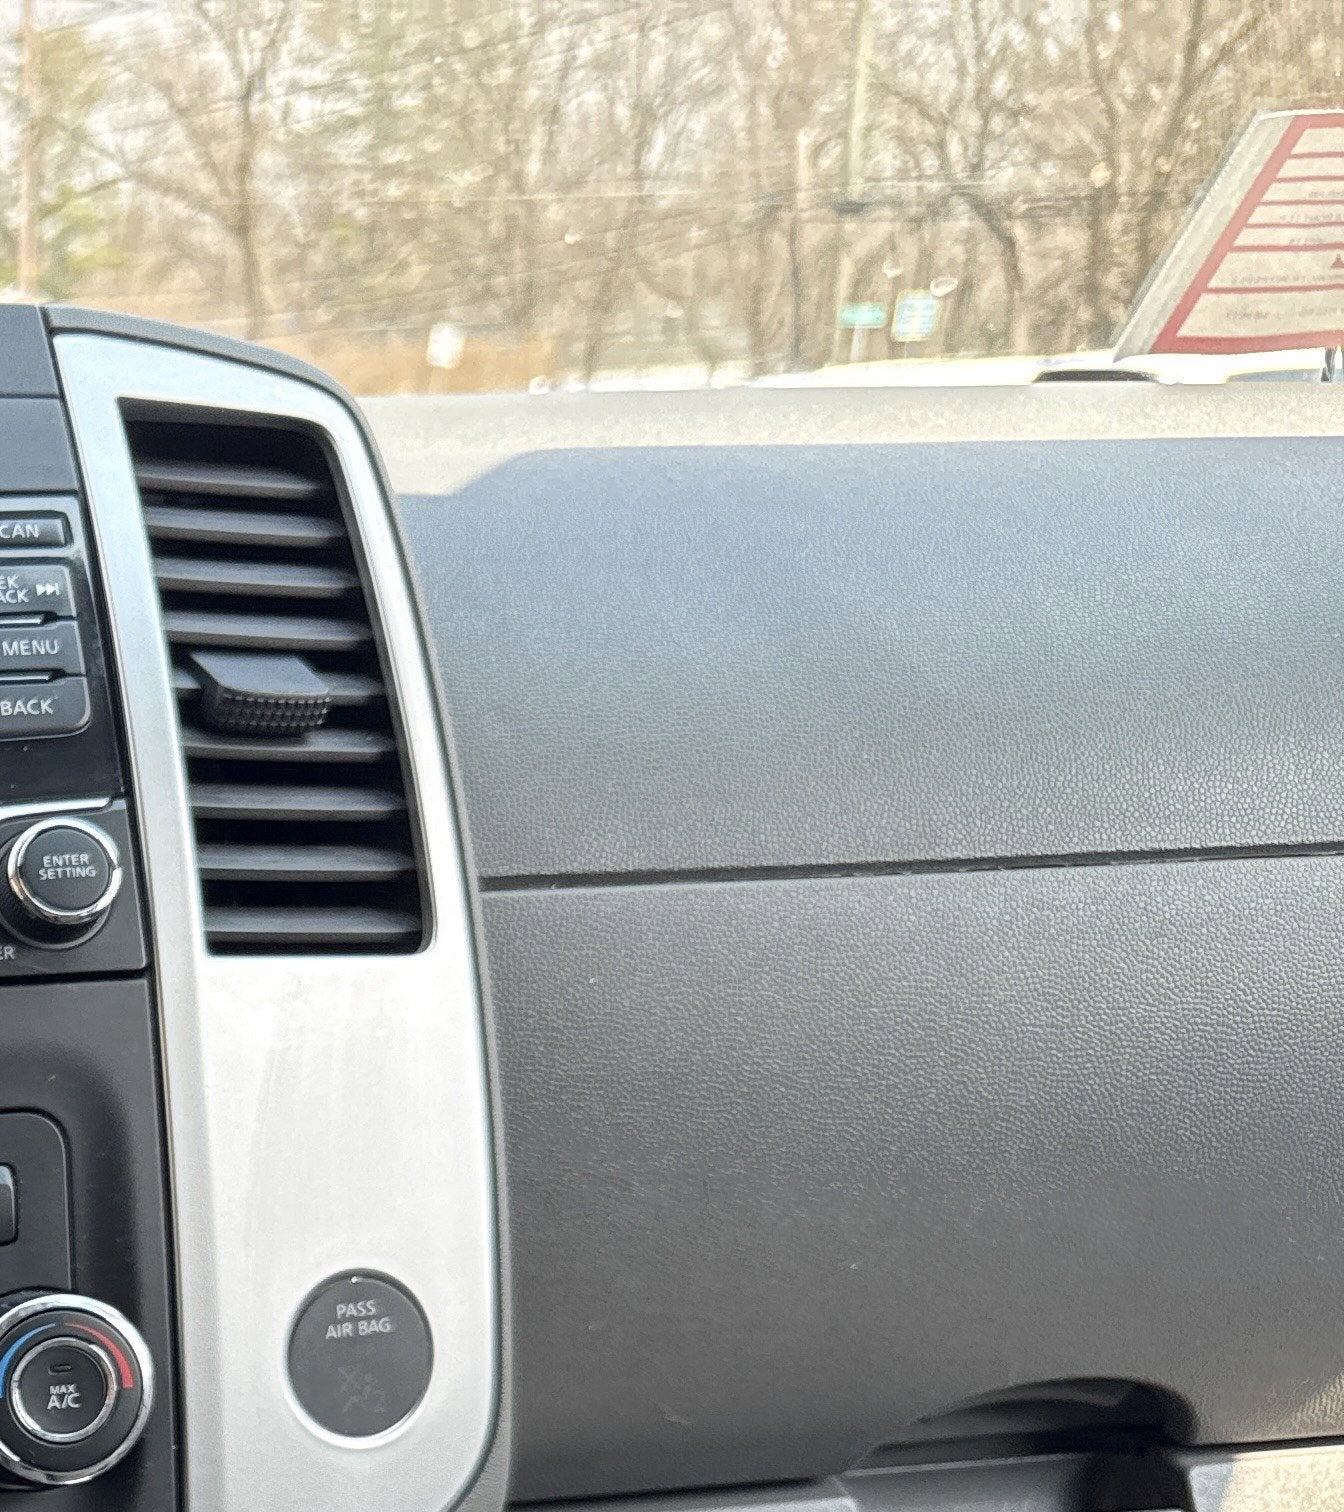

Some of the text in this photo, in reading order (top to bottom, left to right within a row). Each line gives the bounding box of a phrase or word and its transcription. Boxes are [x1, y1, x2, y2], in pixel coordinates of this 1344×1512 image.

[2, 639, 60, 657] MENU
[0, 697, 55, 716] BACK
[42, 853, 90, 868] ENTER
[38, 864, 97, 881] SETTING
[336, 1299, 378, 1319] PASS
[325, 1317, 392, 1340] AIR BAG
[49, 1384, 78, 1395] MAX
[47, 1392, 81, 1410] A/C
